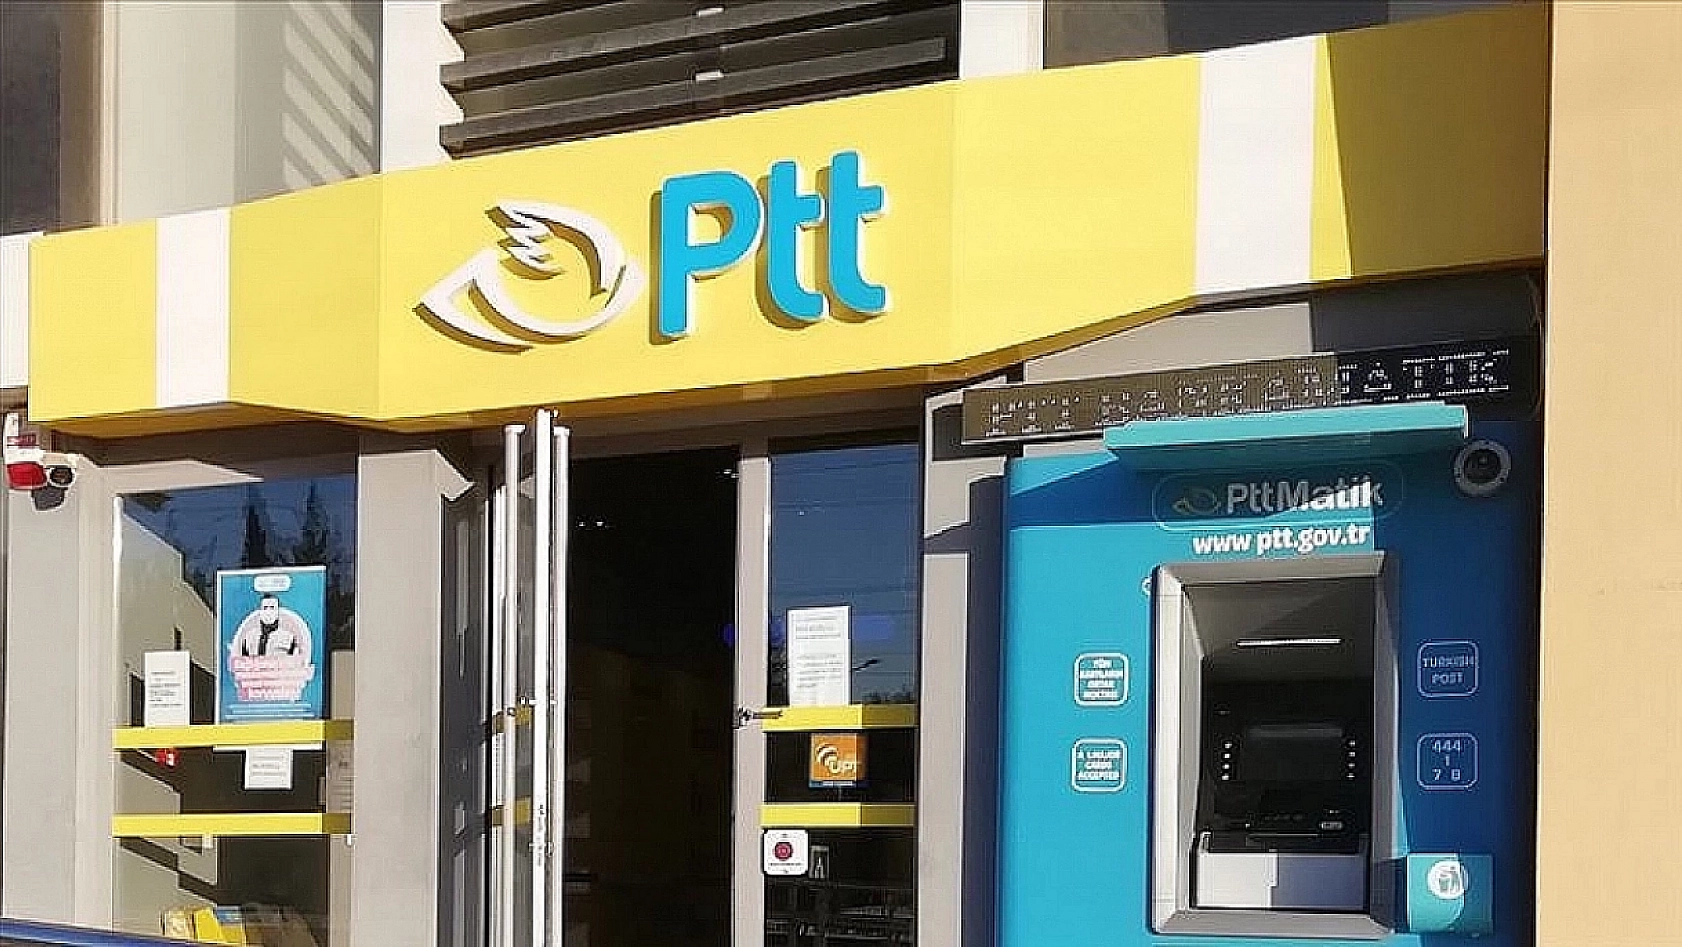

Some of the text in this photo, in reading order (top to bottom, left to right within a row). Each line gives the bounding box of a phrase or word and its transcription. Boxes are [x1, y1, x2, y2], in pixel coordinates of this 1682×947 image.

[659, 149, 888, 337] Ptt
[1227, 473, 1384, 515] PttMatik
[1431, 671, 1464, 685] POST
[1434, 740, 1461, 753] 444
